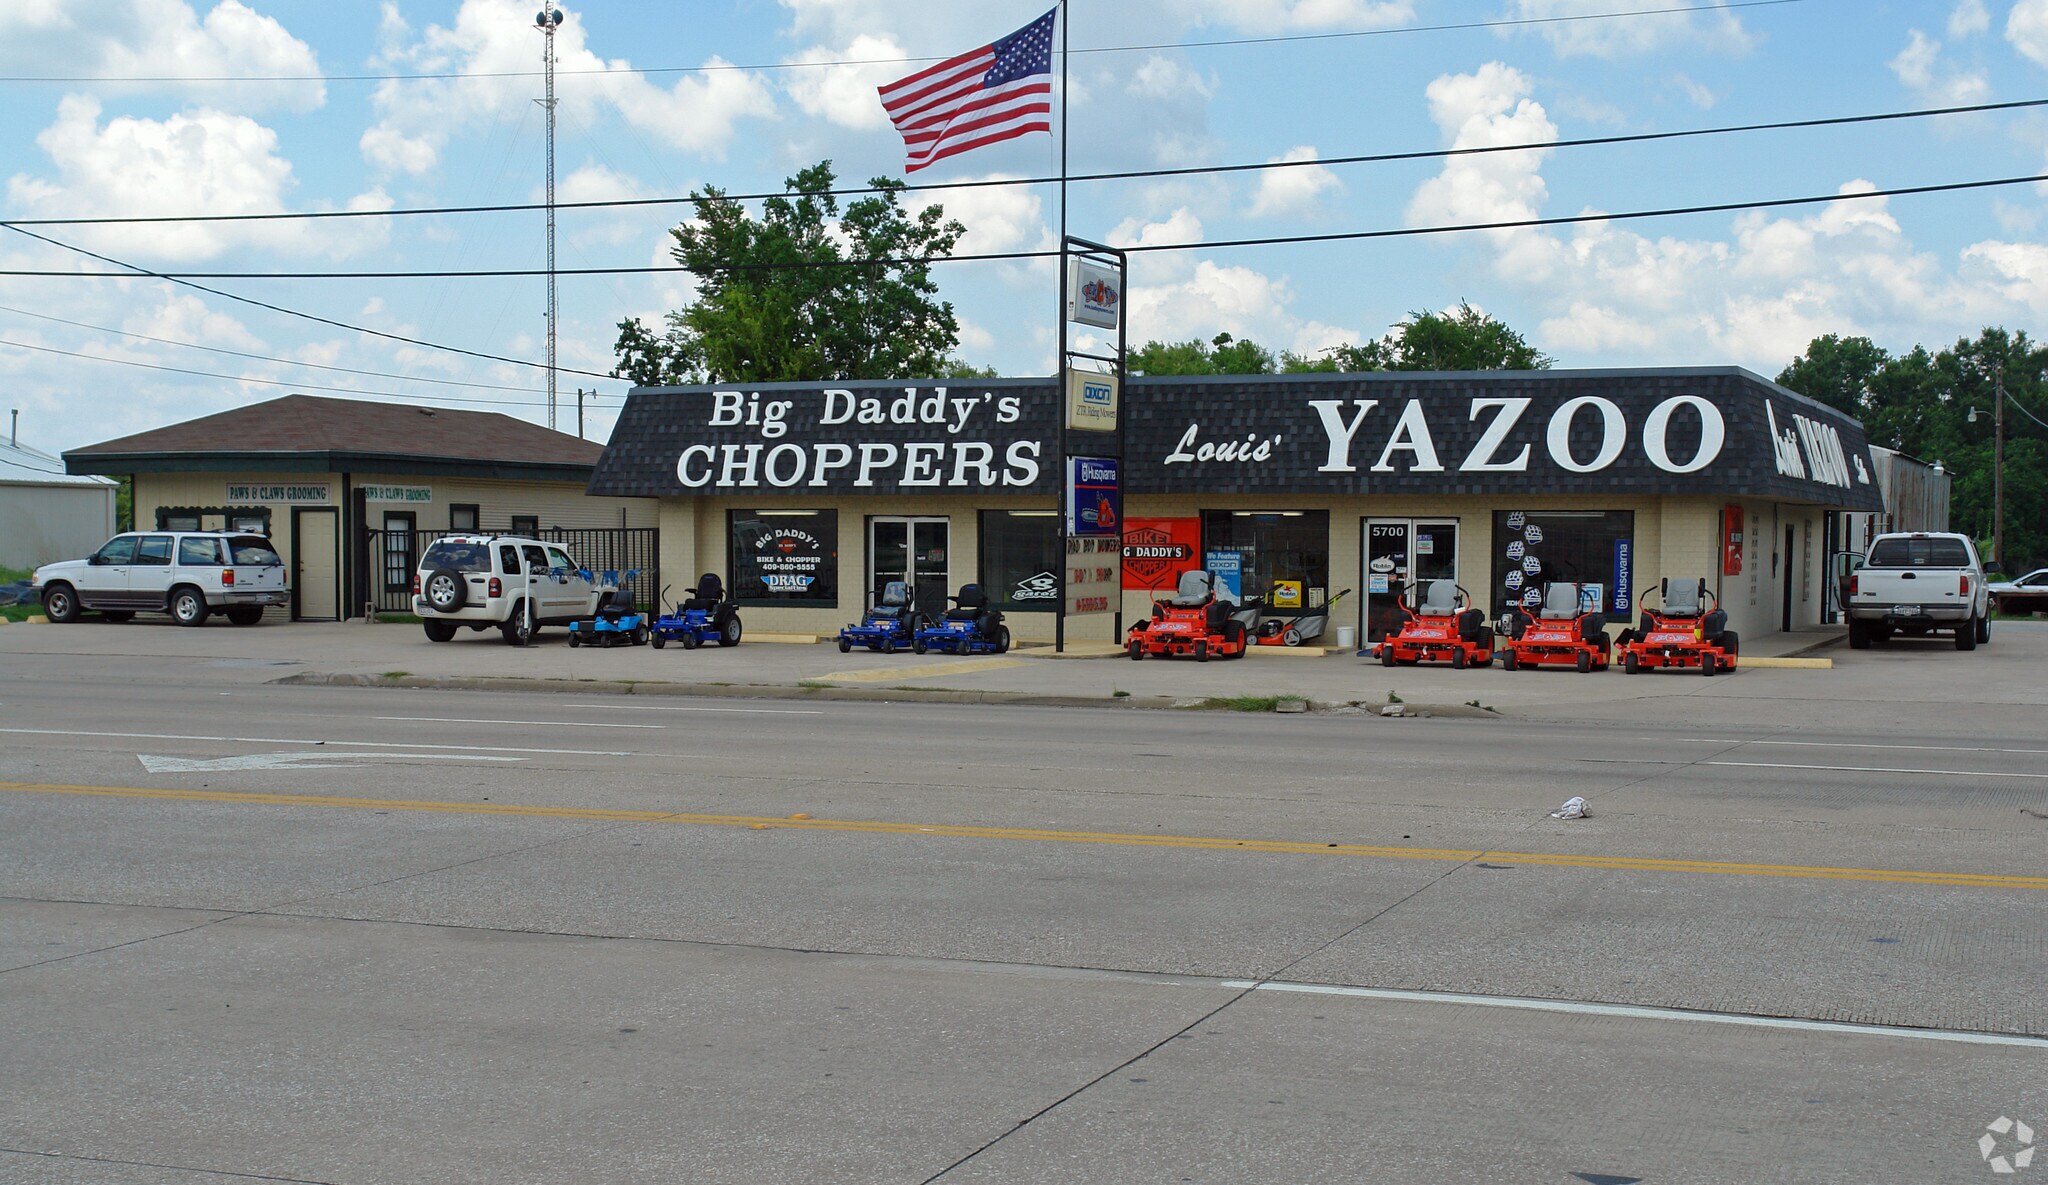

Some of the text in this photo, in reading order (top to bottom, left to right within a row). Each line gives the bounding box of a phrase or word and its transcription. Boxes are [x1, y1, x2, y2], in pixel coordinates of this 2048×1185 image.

[708, 387, 1021, 438] Big Daddy's
[1309, 396, 1725, 473] YAZOO
[676, 441, 1041, 487] CHOPPERS
[1088, 465, 1116, 482] Husqvarna
[229, 487, 327, 500] PAWS & CLAWS GROOMING
[364, 487, 378, 499] AWS
[385, 488, 404, 500] CLAWS
[405, 488, 431, 501] GROOMING
[755, 529, 820, 549] BIG DADDY'S
[1128, 531, 1167, 544] BIKE
[1372, 527, 1404, 537] 5700
[1136, 547, 1182, 558] DADDY'S
[1217, 552, 1241, 560] Feature
[1127, 560, 1167, 576] CHOPPER
[1618, 543, 1629, 598] Husqvarna
[768, 574, 807, 586] DRAG
[768, 585, 808, 593] Specialties
